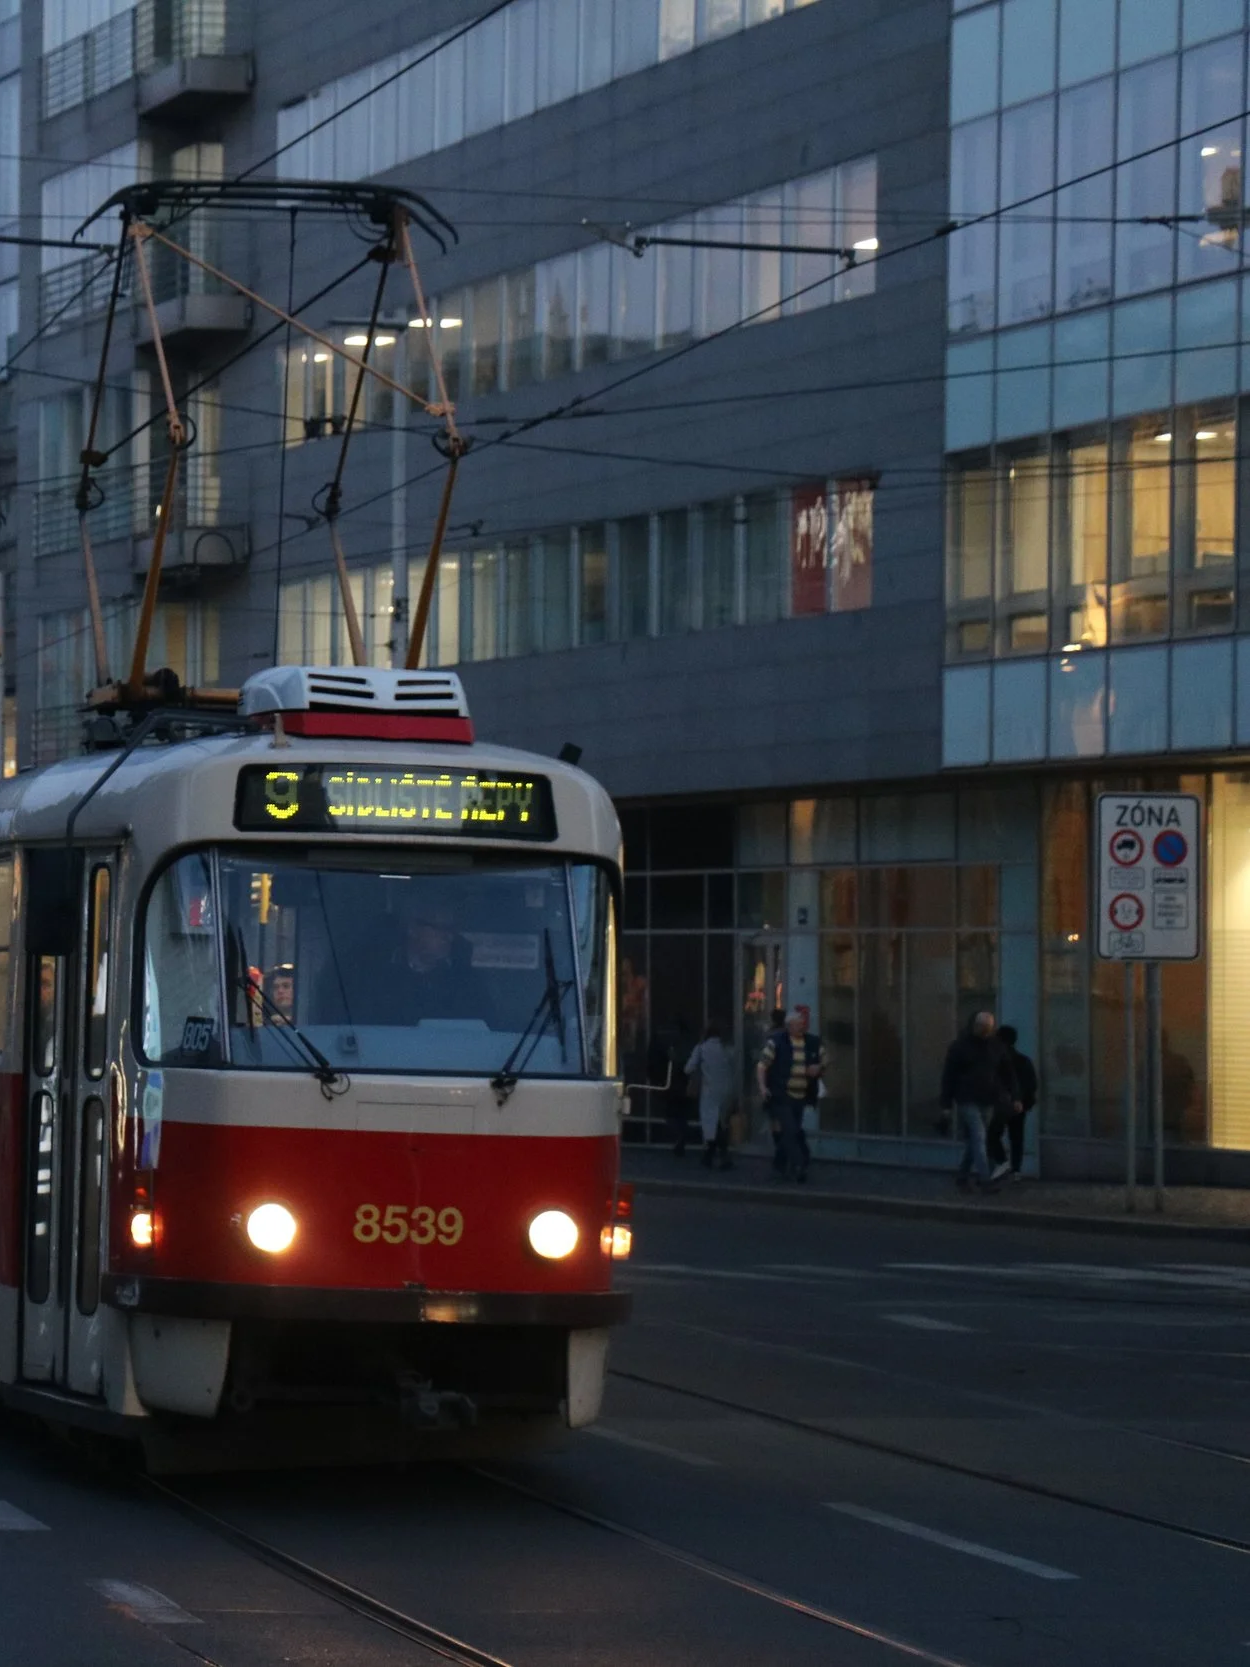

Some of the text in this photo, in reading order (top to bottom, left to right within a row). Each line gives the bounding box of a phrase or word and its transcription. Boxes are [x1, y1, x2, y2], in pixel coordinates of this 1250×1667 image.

[264, 771, 299, 819] 9
[1115, 800, 1181, 826] ZÓNA
[352, 1203, 464, 1246] 8539
